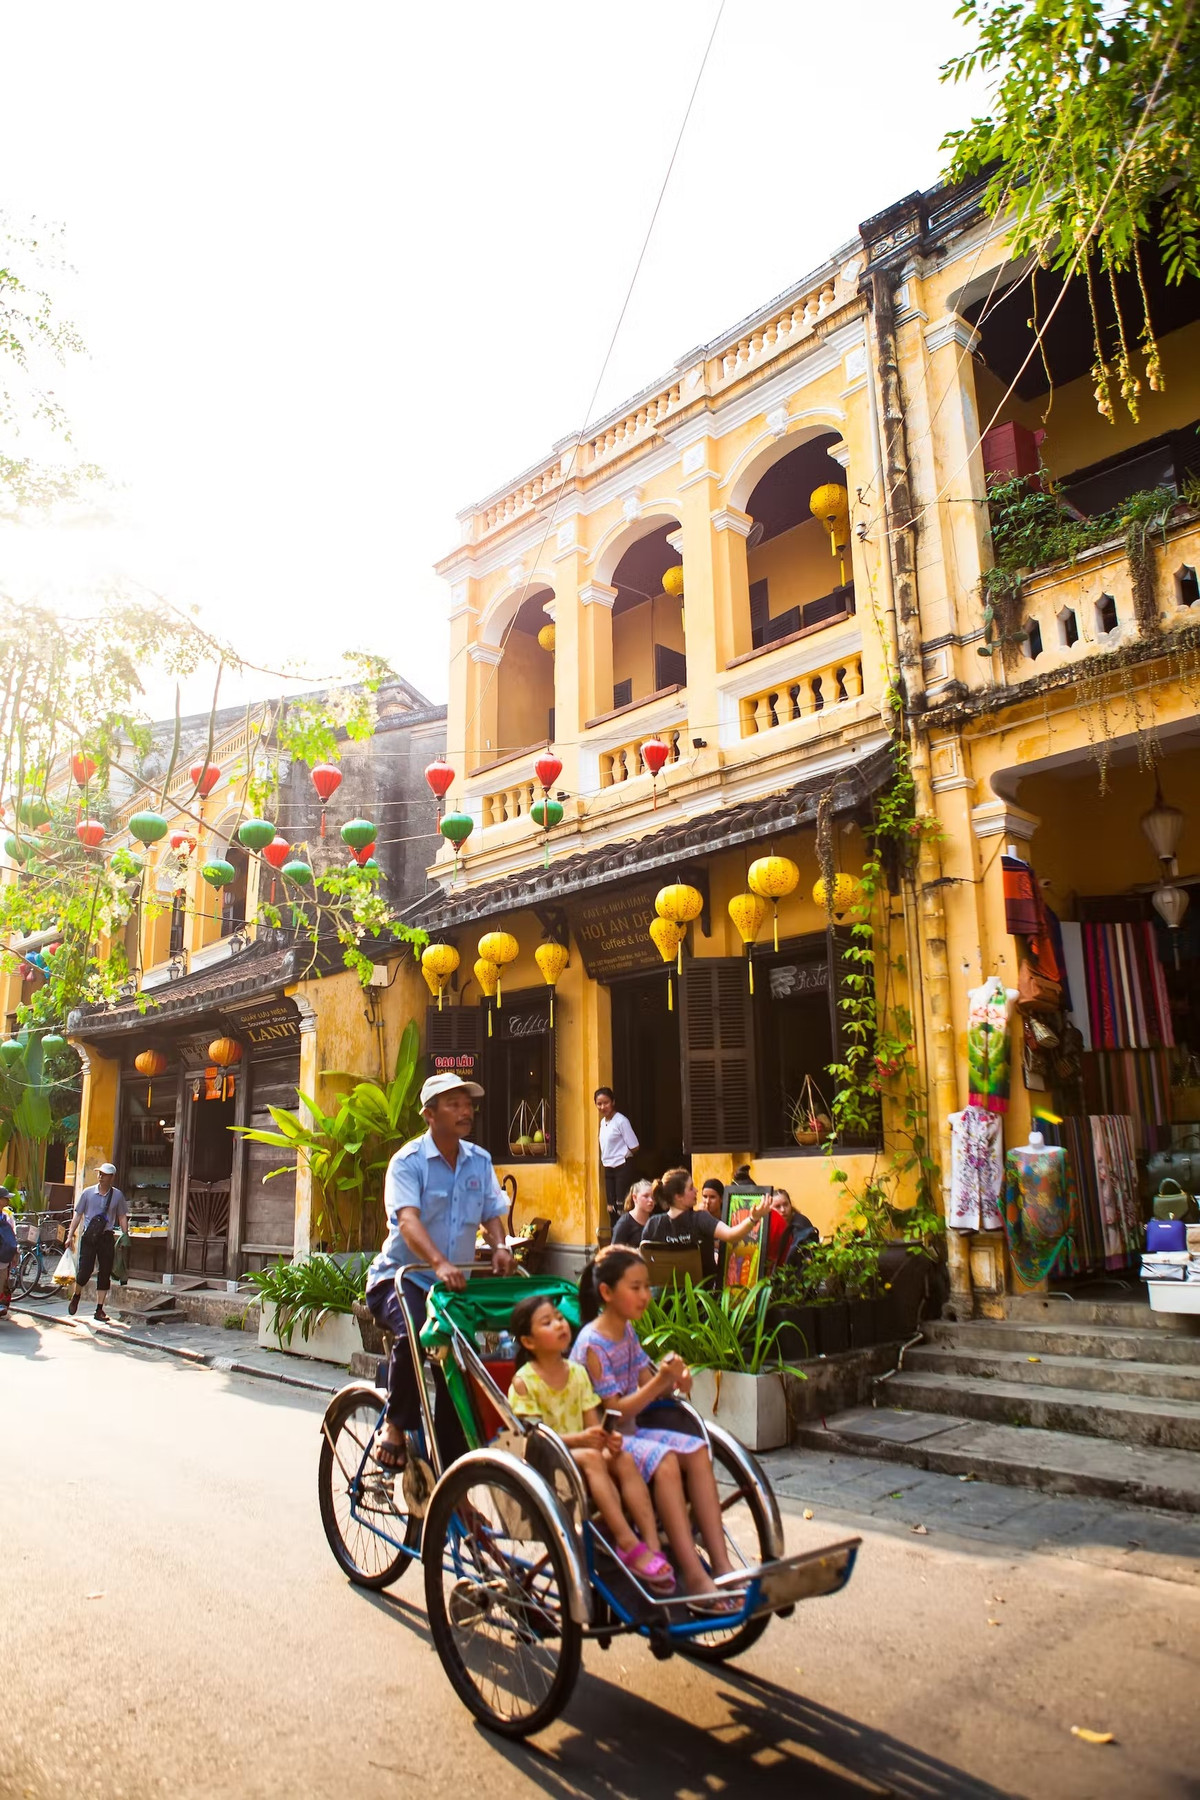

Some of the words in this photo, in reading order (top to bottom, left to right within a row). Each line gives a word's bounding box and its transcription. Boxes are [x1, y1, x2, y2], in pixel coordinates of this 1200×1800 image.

[580, 922, 607, 941] HOI
[610, 916, 630, 933] AN
[601, 937, 627, 951] Coffee
[627, 935, 635, 945] &
[635, 932, 651, 943] foo
[247, 1019, 271, 1028] Souvenir
[248, 1021, 297, 1043] LANIT
[435, 1056, 455, 1068] CAO
